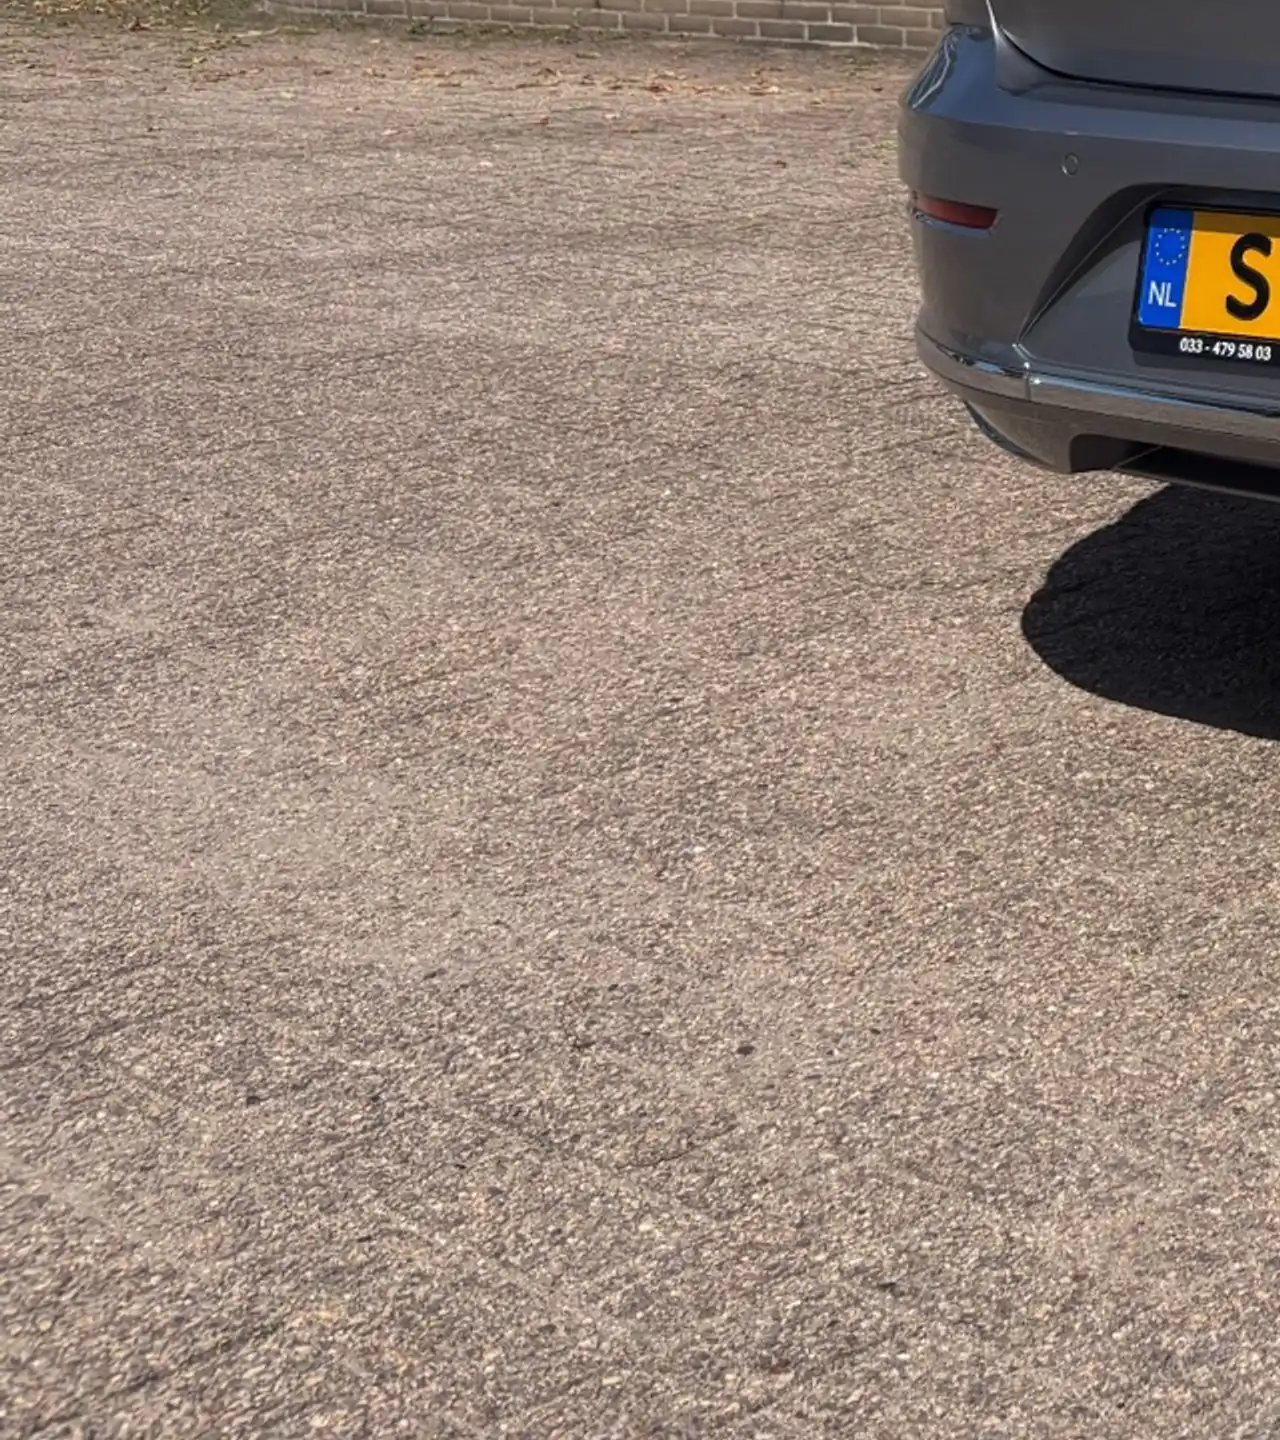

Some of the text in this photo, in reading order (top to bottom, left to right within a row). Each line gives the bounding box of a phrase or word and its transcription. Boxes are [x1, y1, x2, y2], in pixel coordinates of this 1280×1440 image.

[1148, 280, 1177, 309] NL
[1179, 337, 1203, 353] 033
[1212, 341, 1236, 358] 479
[1237, 344, 1254, 359] 58
[1255, 346, 1272, 361] 03
